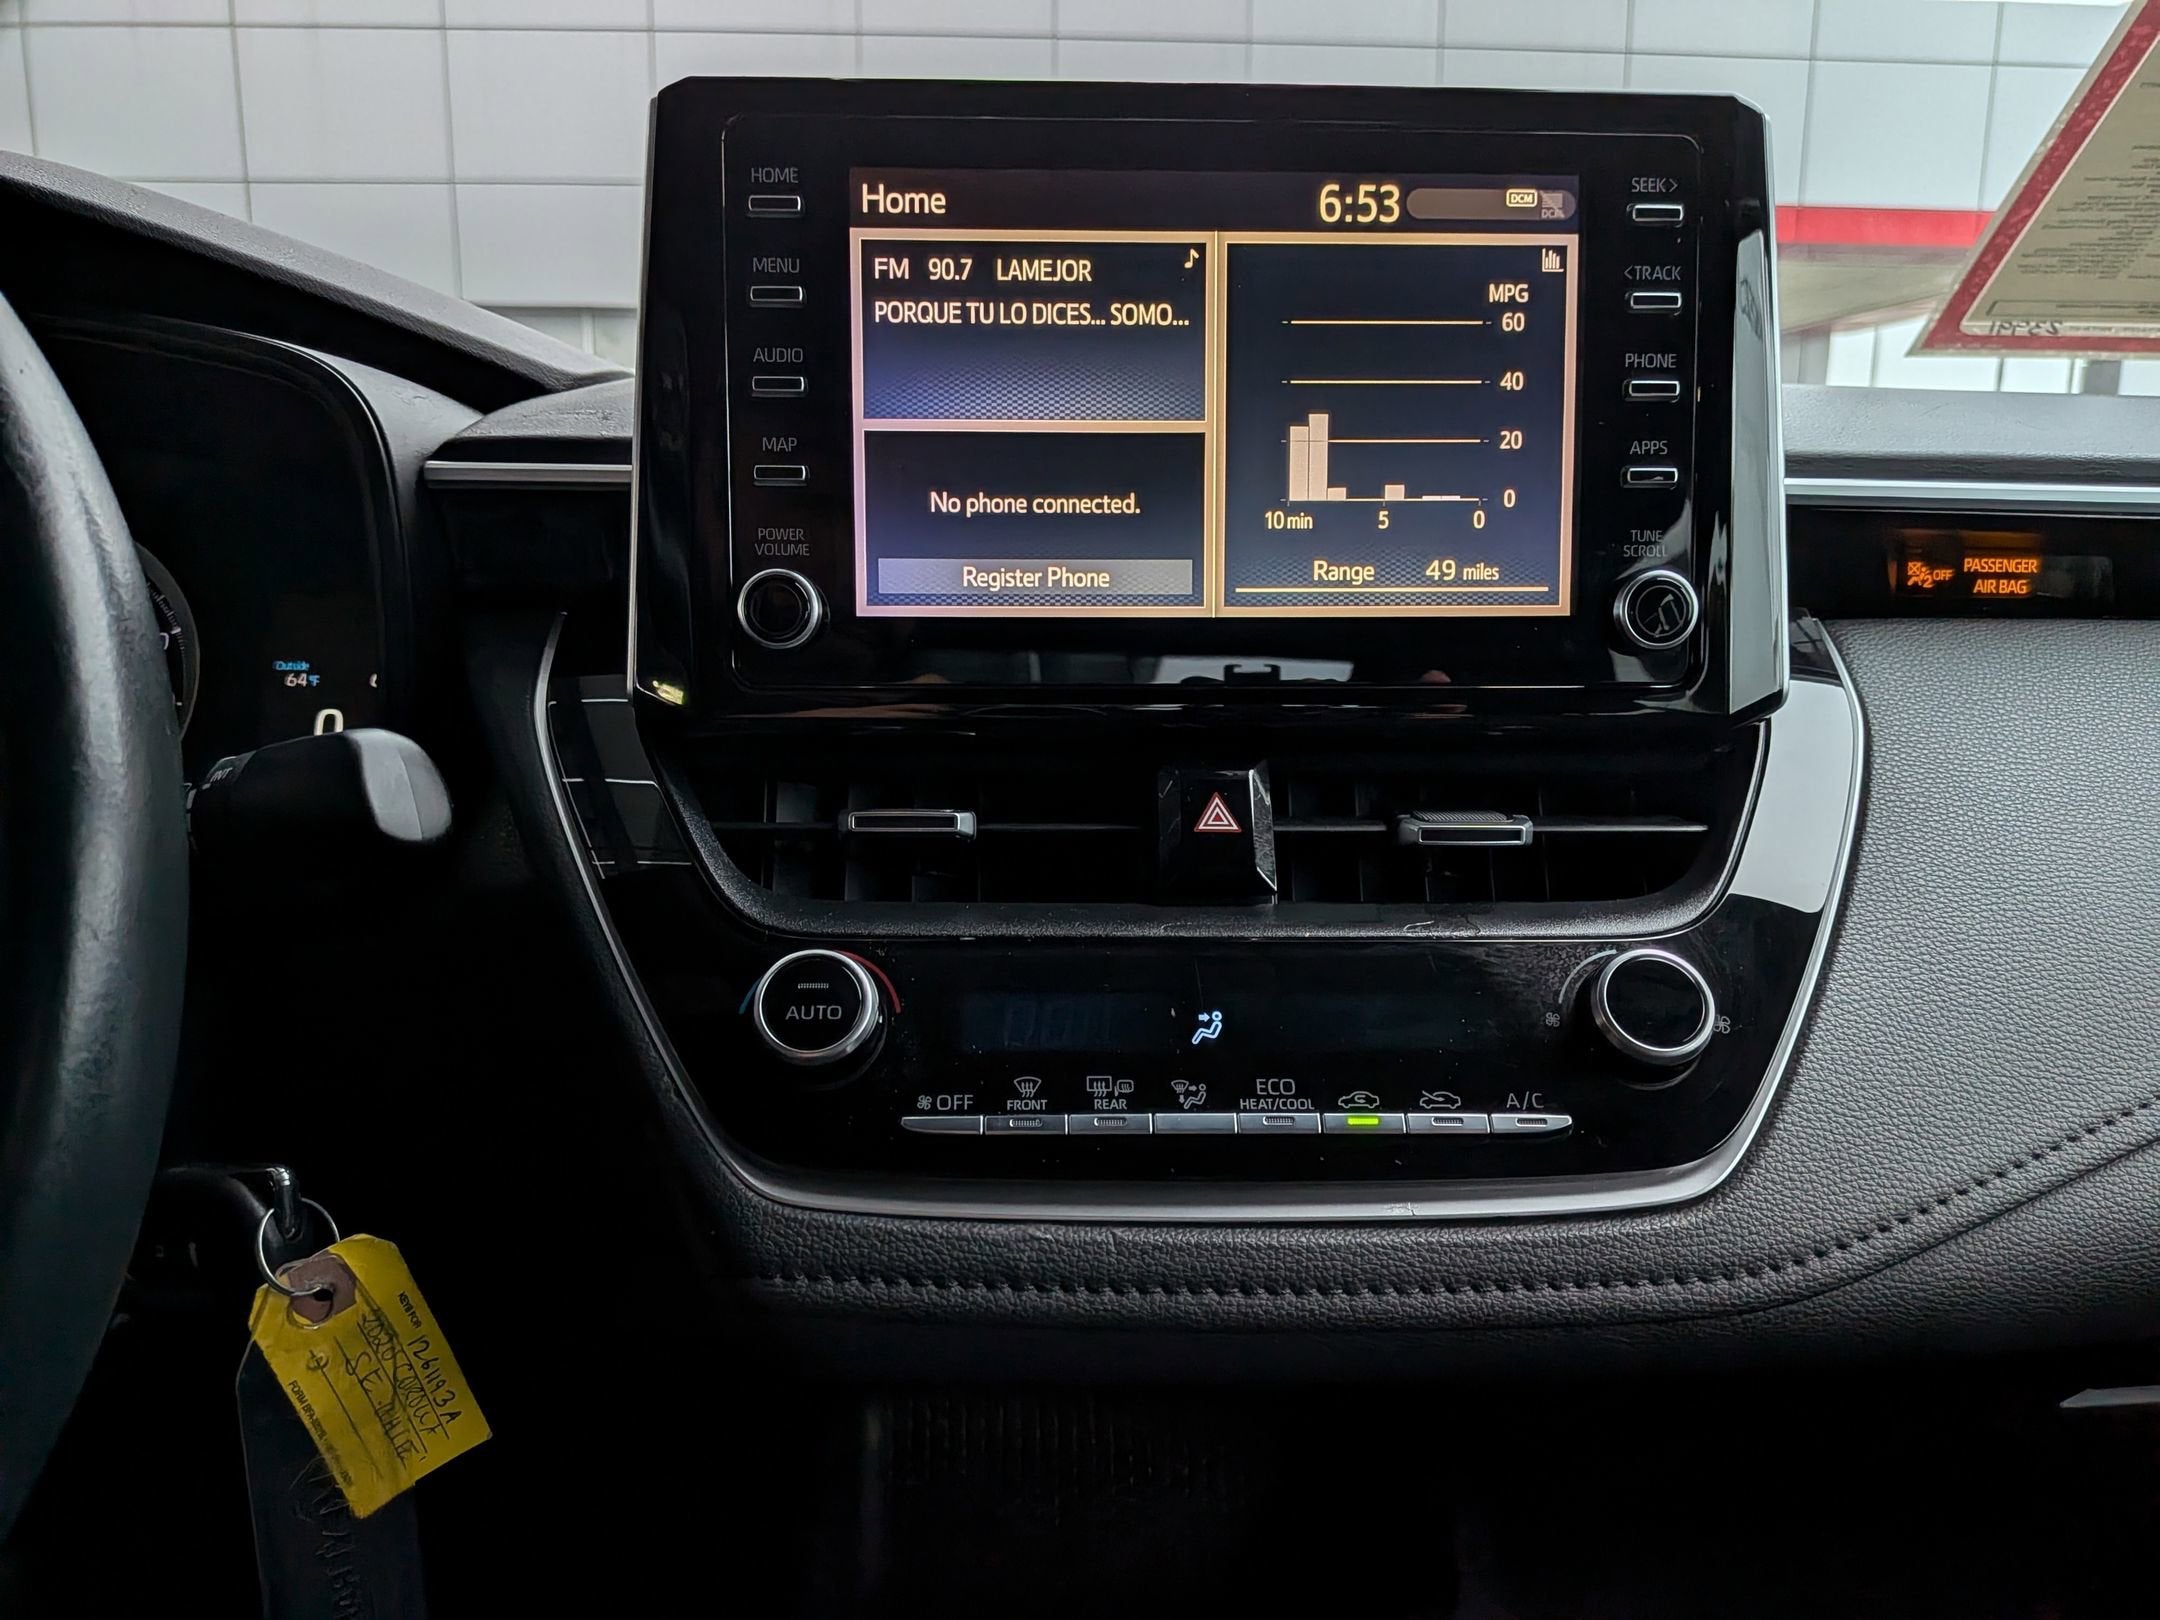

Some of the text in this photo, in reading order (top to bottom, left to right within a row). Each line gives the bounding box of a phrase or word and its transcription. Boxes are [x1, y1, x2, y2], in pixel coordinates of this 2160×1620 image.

[751, 167, 799, 183] HOME
[862, 183, 946, 214] Home
[1319, 183, 1401, 223] 6:53
[1511, 194, 1533, 203] DCM
[752, 257, 800, 273] MENU
[874, 257, 1092, 282] FM 90.7 LAMEJOR
[1488, 283, 1529, 303] MPG
[875, 301, 1189, 326] PORQUE TU LO DICES... SOMO...
[1502, 312, 1525, 332] 60
[753, 347, 804, 363] AUDIO
[1625, 353, 1677, 368] PHONE
[1500, 371, 1524, 391] 40
[762, 436, 798, 452] MAP
[1500, 430, 1522, 450] 20
[1629, 440, 1668, 455] APPS
[930, 491, 1141, 518] No phone connected.
[1503, 489, 1516, 508] 0
[1265, 511, 1313, 529] 10 min
[1378, 511, 1389, 529] 5
[1473, 511, 1485, 529] 0
[757, 528, 805, 541] POWER
[1630, 530, 1663, 542] TUNE
[755, 543, 810, 556] VOLUME
[1623, 544, 1668, 558] SCROLL
[1313, 560, 1500, 585] Range 49 miles
[1963, 558, 2038, 573] PASSENGER
[963, 566, 1110, 591] Register Phone
[1933, 569, 1953, 581] OFF
[1973, 579, 2028, 594] AIR BAG
[273, 660, 310, 671] Outside
[785, 1005, 842, 1020] AUTO
[1256, 1078, 1296, 1095] ECO
[937, 1094, 974, 1110] OFF
[1007, 1099, 1048, 1111] FRONT
[1094, 1098, 1127, 1110] REAR
[1240, 1098, 1315, 1110] HEAT/COOL
[1507, 1091, 1545, 1109] A/C
